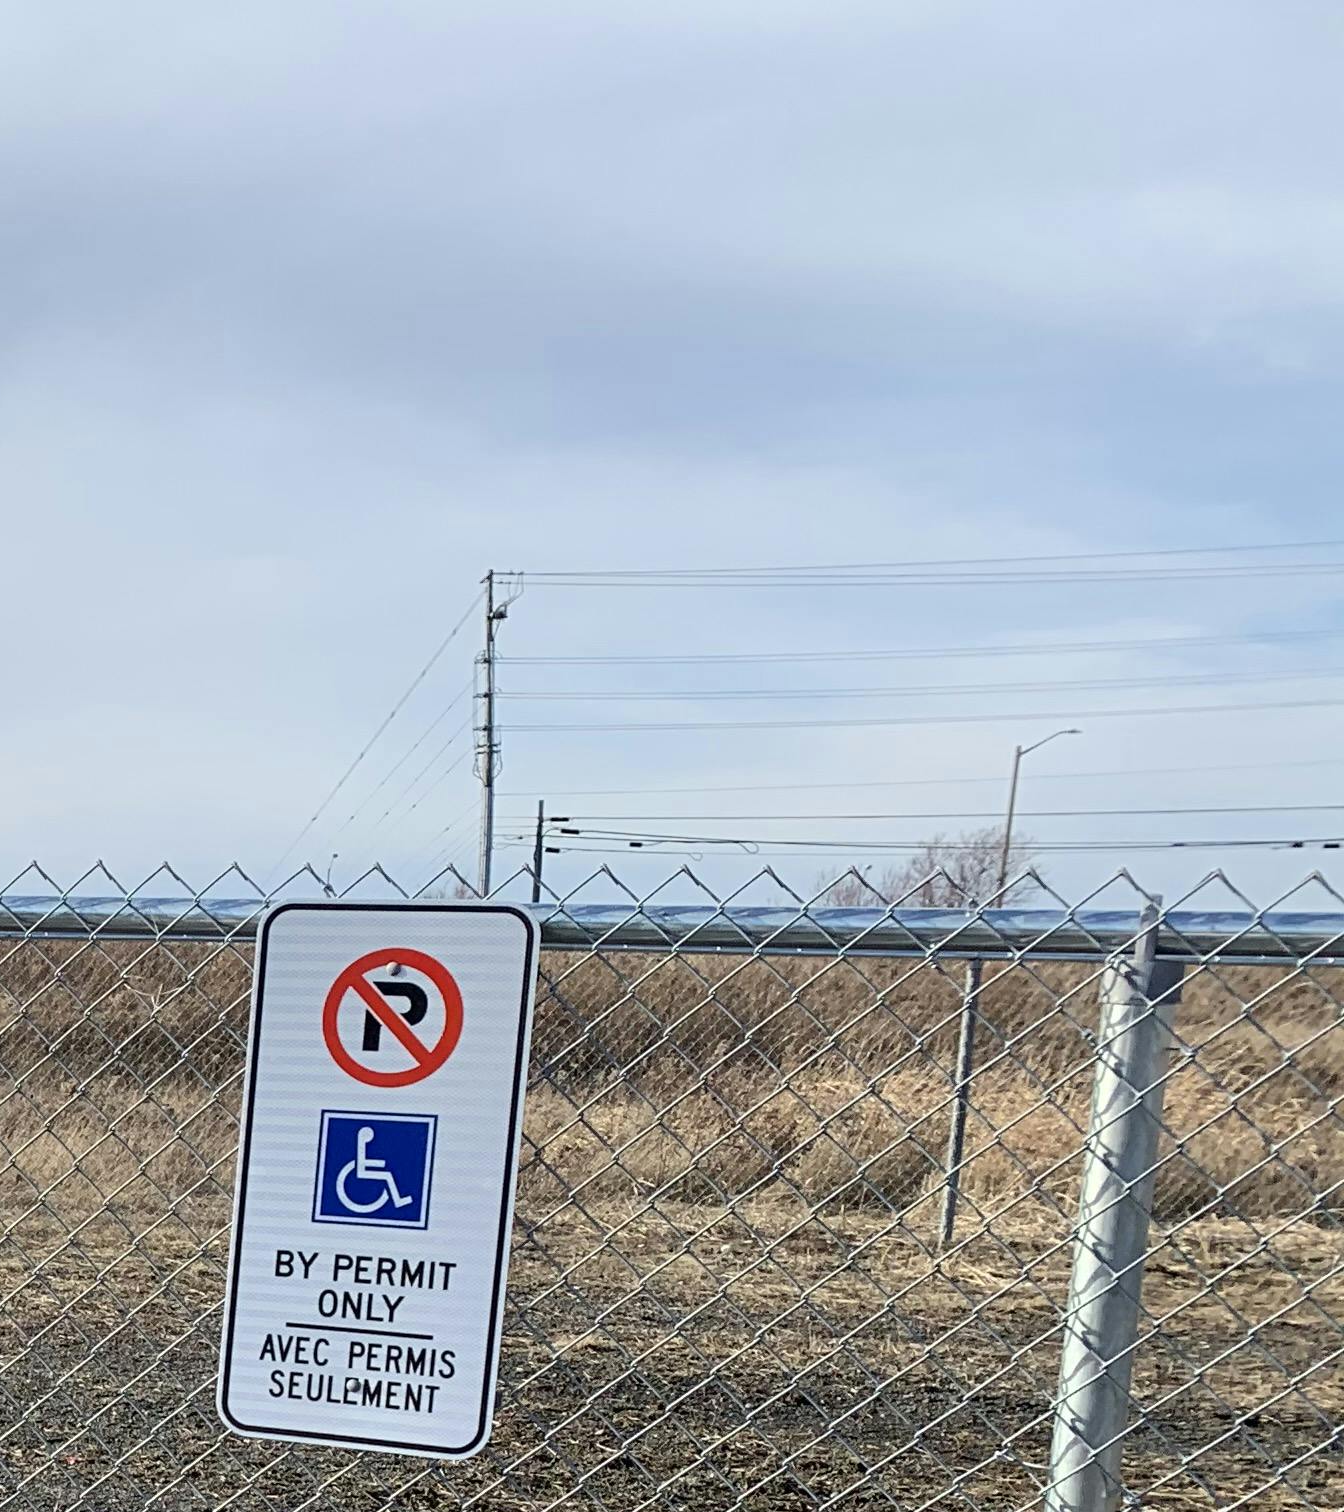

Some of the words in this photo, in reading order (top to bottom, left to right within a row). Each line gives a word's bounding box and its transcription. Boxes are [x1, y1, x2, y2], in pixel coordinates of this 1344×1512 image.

[274, 1249, 320, 1279] BY
[332, 1253, 457, 1291] PERMIT
[318, 1289, 406, 1323] ONLY
[259, 1333, 330, 1367] AVEC
[348, 1341, 456, 1379] PERMIS
